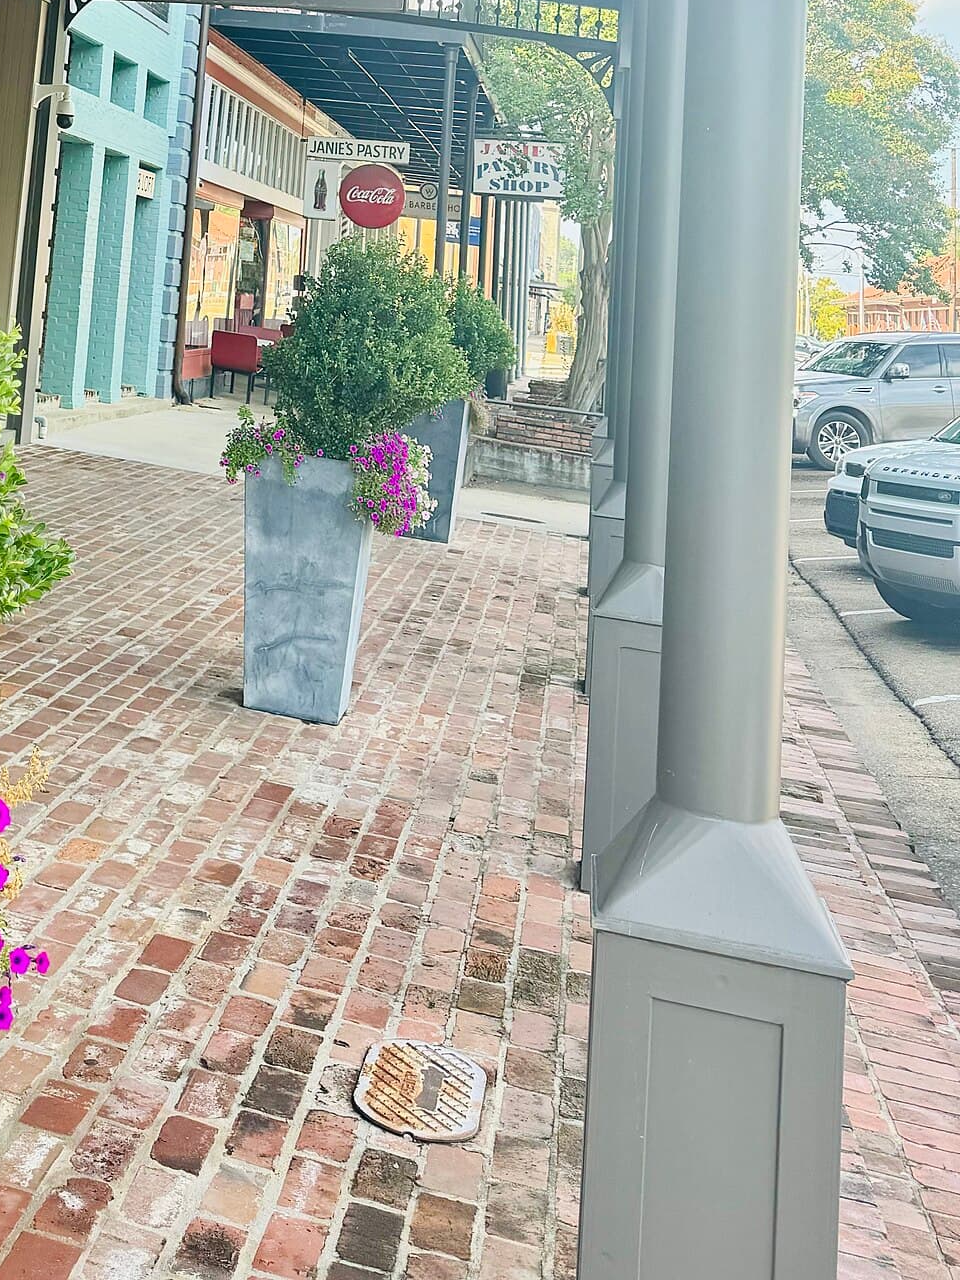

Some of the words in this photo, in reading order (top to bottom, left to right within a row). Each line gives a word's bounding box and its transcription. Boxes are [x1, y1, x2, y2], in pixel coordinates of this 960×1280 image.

[309, 140, 354, 156] JANIE'S
[356, 143, 406, 160] PASTRY
[488, 178, 550, 193] SHOP
[409, 200, 437, 211] BARBE
